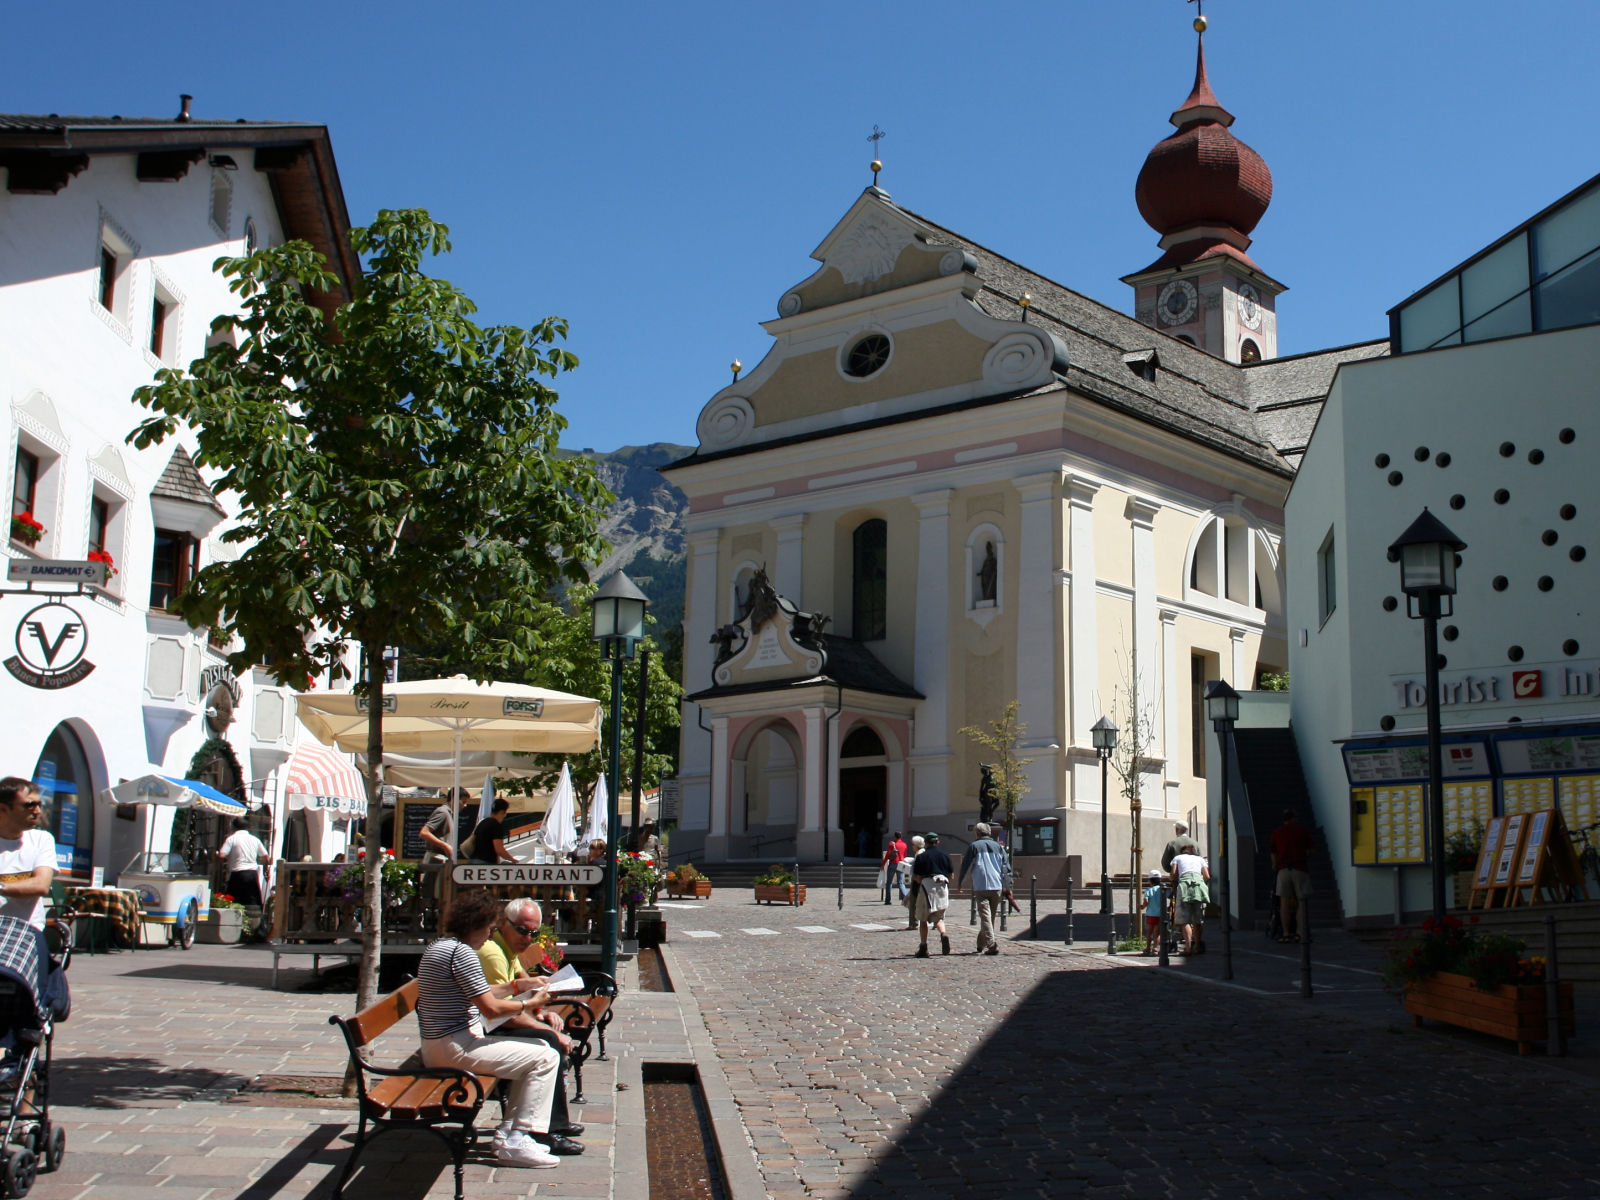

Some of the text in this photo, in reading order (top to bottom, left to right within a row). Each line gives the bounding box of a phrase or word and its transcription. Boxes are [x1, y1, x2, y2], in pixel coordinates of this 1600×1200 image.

[31, 565, 83, 576] BANCOMAT
[8, 659, 89, 688] Banca Popolare
[359, 698, 394, 709] FOST
[429, 697, 470, 710] Prosit
[506, 700, 541, 712] FORST
[316, 796, 340, 808] EIS
[463, 868, 594, 881] RESTAURANT
